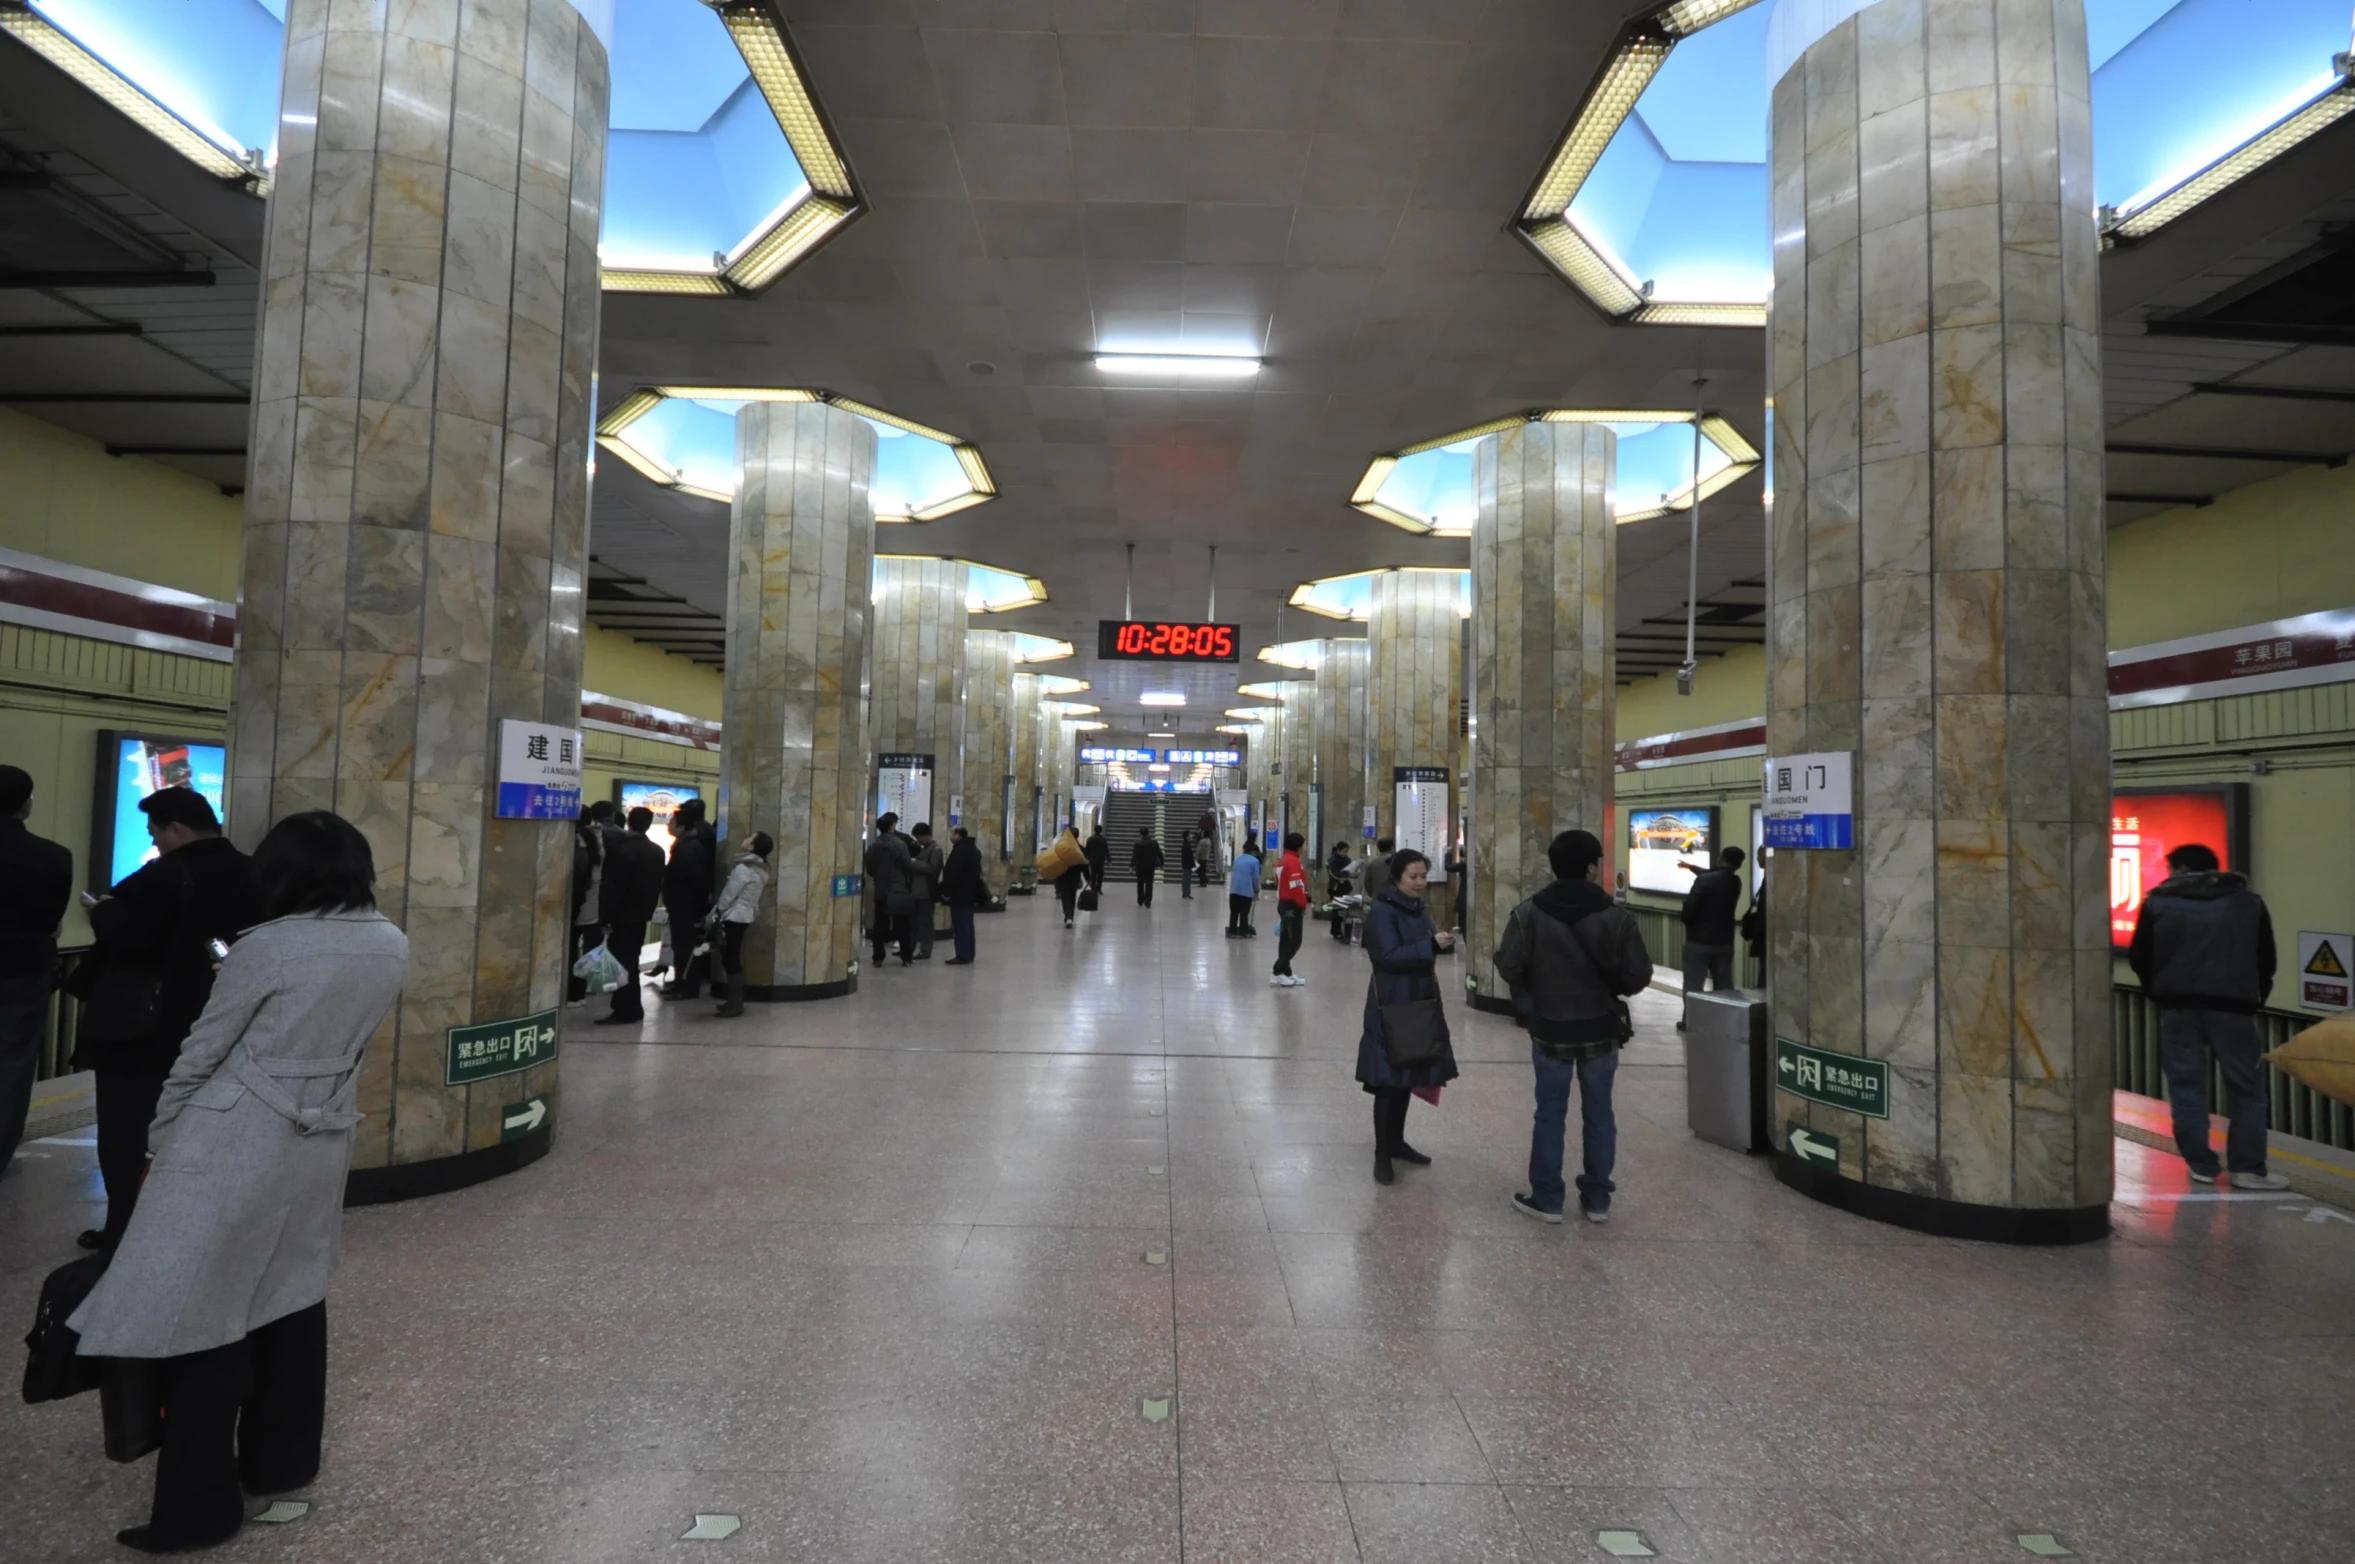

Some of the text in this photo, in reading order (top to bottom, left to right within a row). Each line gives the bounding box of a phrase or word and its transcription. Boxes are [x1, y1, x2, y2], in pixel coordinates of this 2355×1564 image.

[1117, 624, 1232, 656] 10:28:05
[2235, 641, 2292, 665] 苹果园
[527, 734, 581, 764] 建国
[1764, 765, 1826, 793] 国门
[459, 1036, 511, 1060] 紧急出口
[459, 1053, 508, 1069] EMERGENCY EXIT
[1825, 1065, 1878, 1091] 紧急出口
[1827, 1083, 1876, 1101] EMERGENCY EXIT
